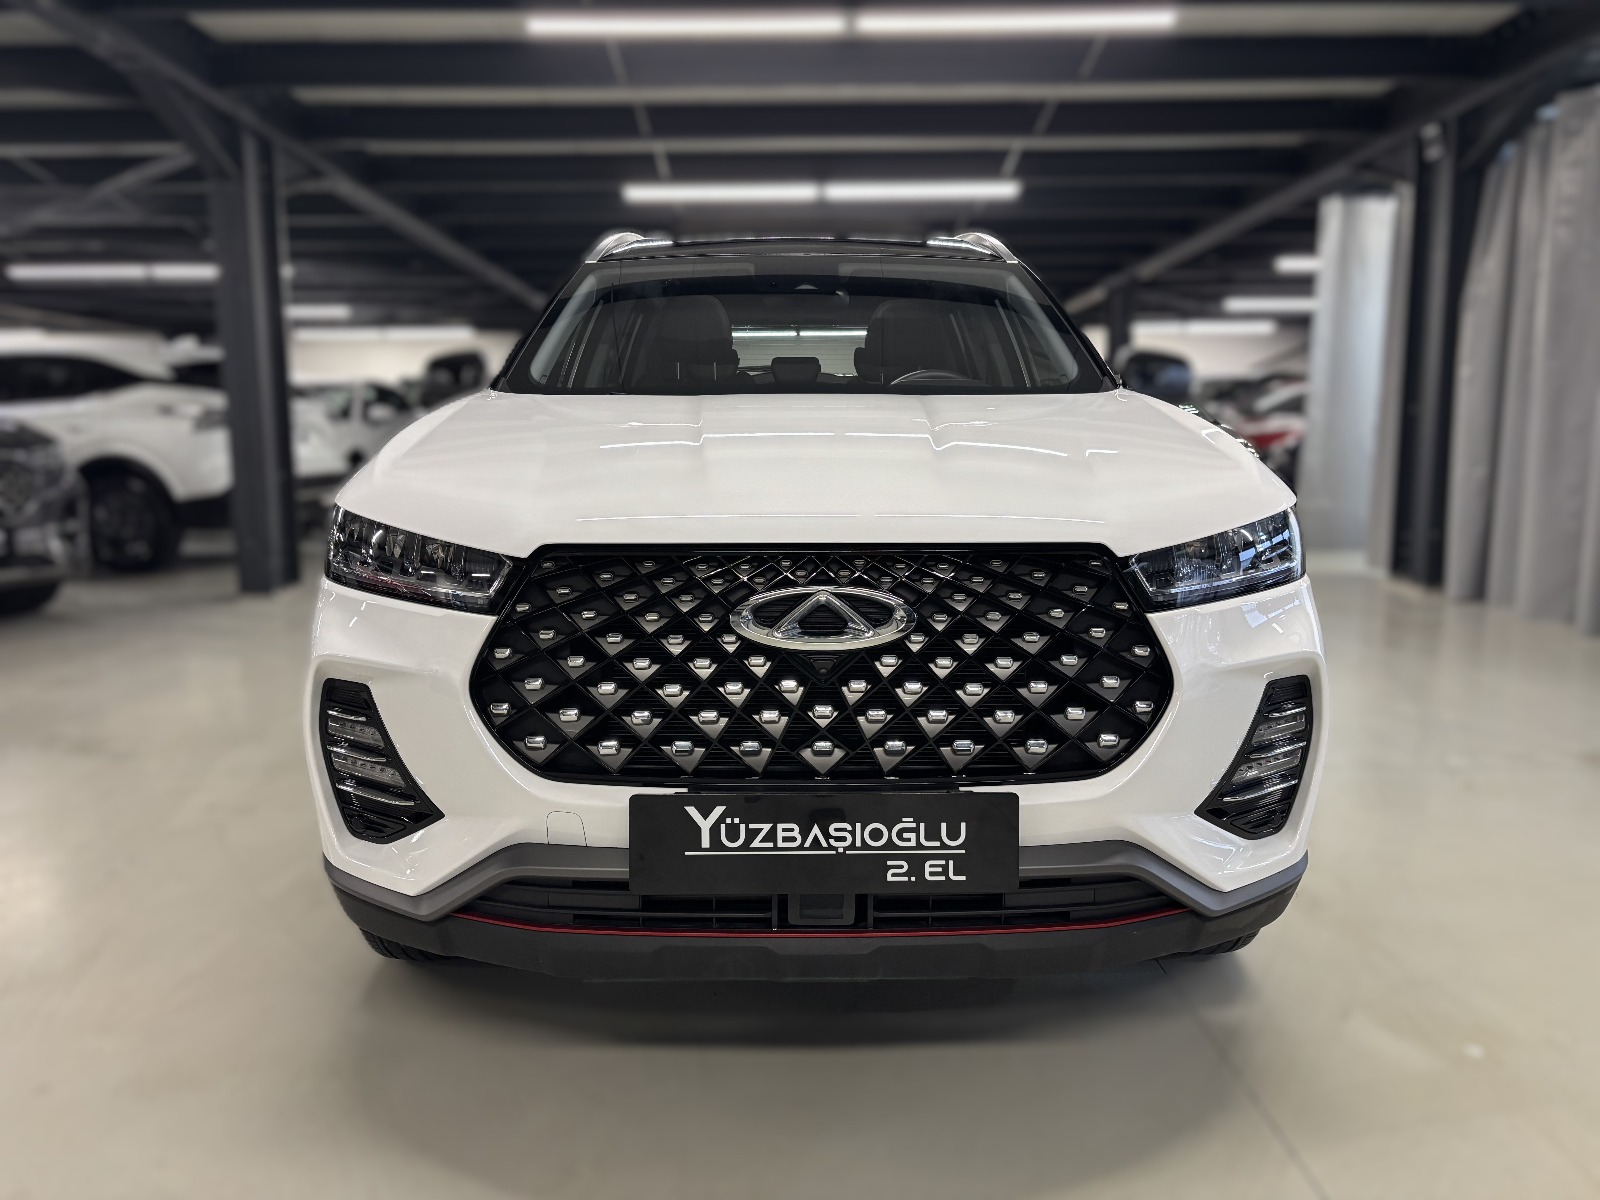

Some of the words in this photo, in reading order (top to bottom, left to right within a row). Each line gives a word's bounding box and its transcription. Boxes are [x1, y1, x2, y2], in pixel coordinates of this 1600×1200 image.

[684, 805, 967, 853] YÜZBAŞIOĞLU
[886, 860, 916, 882] 2.
[924, 859, 967, 881] EL
